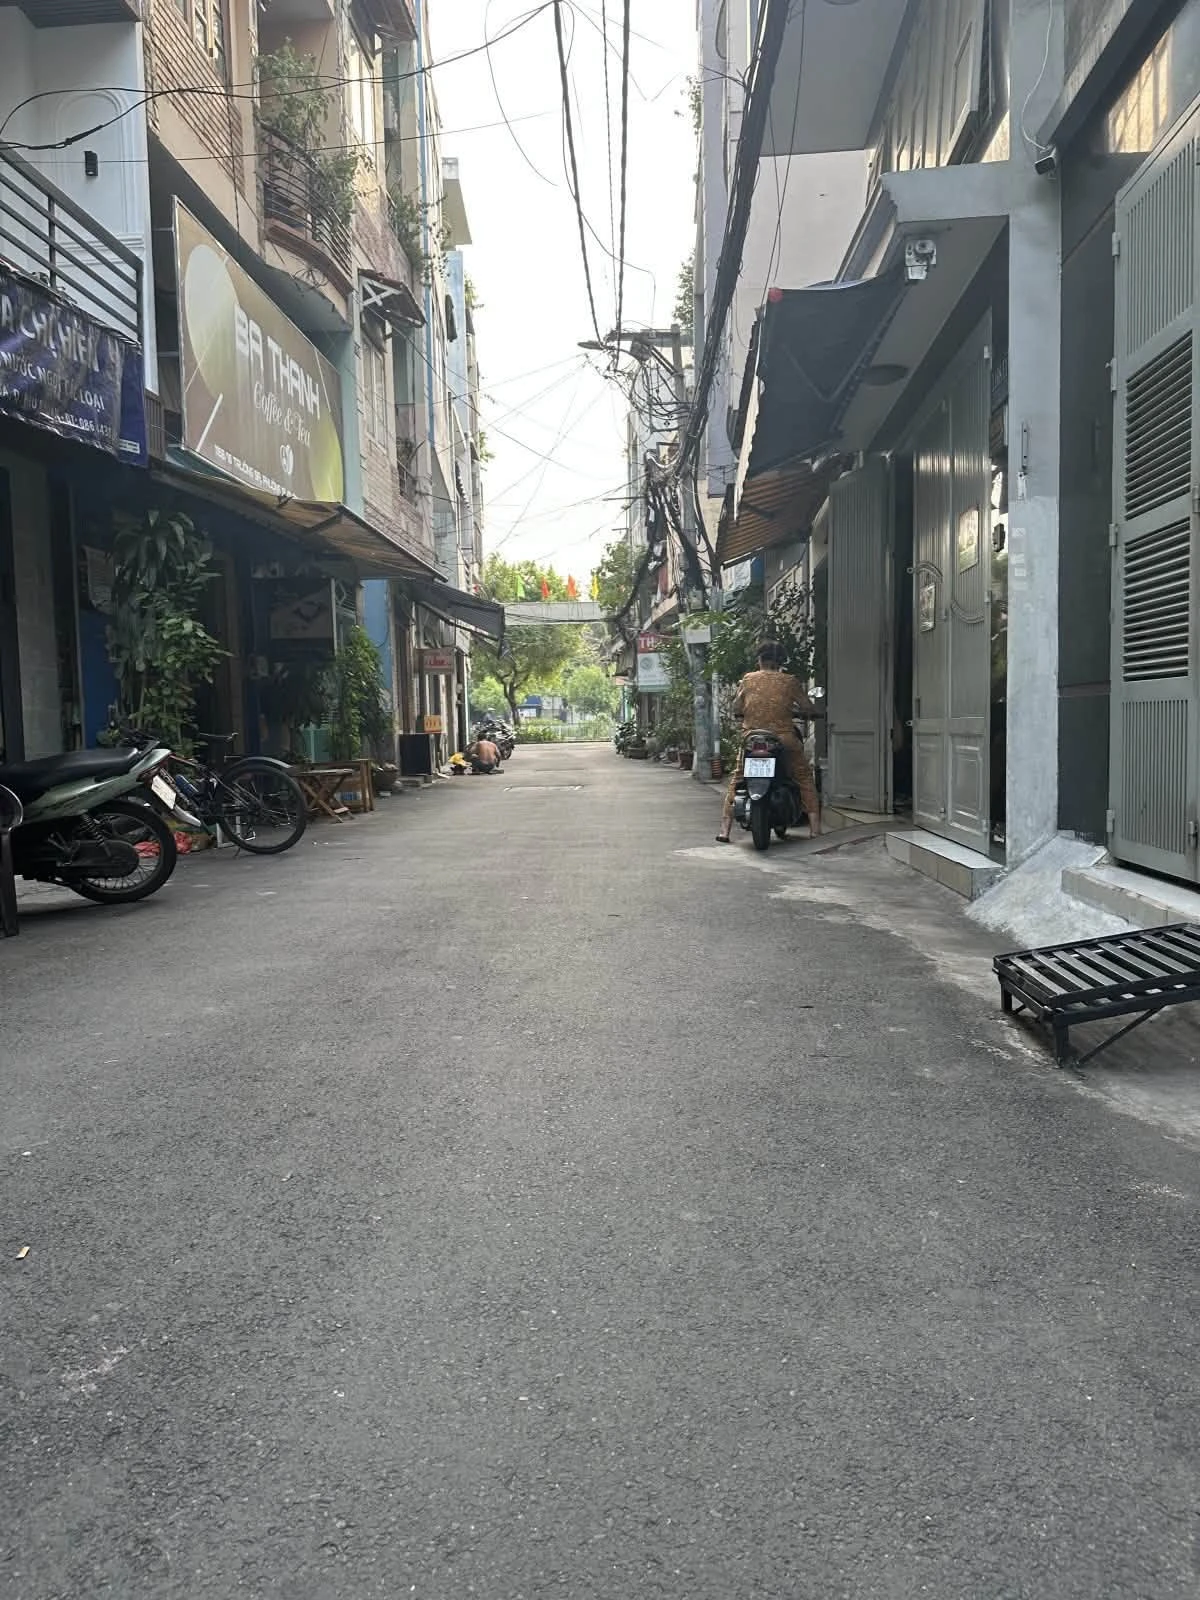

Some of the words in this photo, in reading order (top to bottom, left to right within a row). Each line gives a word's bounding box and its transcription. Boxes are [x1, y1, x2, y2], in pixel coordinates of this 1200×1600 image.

[80, 390, 105, 413] LOẠI
[267, 336, 320, 421] THANH
[254, 381, 282, 426] Coffee
[284, 407, 293, 434] &
[294, 412, 311, 448] Tea
